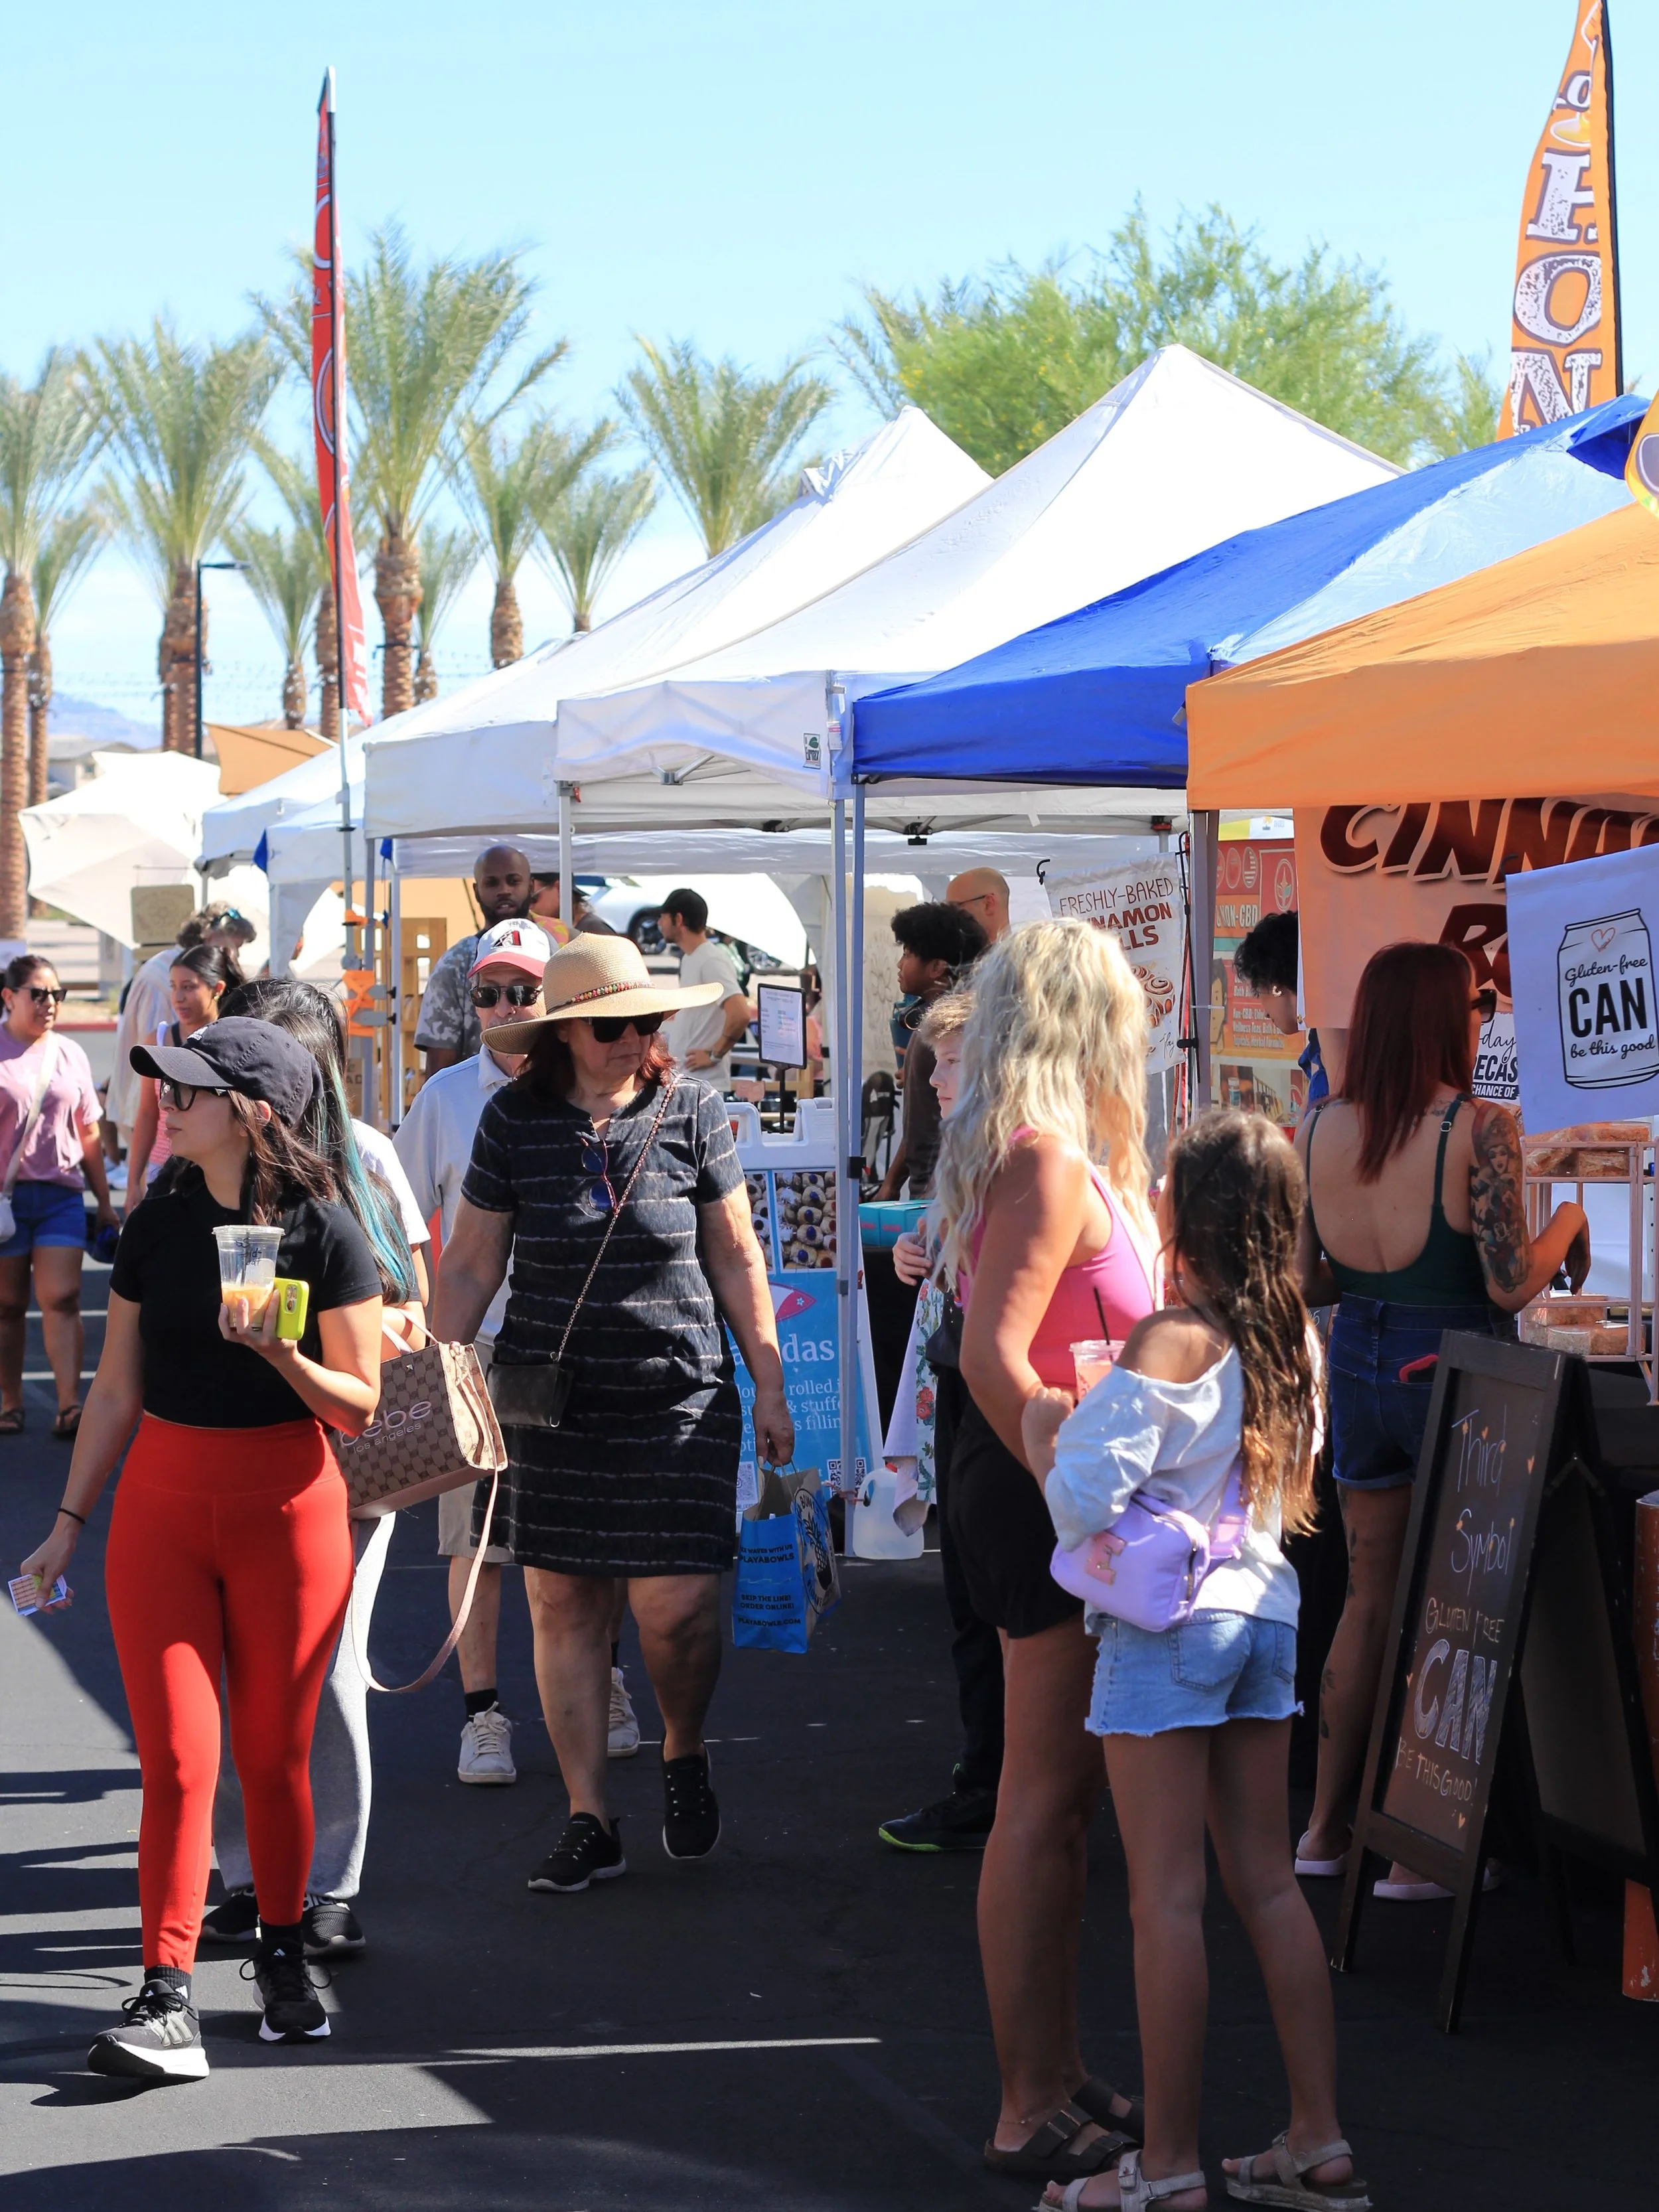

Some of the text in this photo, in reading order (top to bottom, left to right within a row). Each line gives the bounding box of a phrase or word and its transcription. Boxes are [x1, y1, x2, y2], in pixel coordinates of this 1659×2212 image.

[1060, 877, 1173, 917] FRESHLY-BAKED
[1088, 902, 1172, 929] NAMON
[1119, 925, 1159, 950] LLS
[1565, 954, 1648, 987] Gluten-free
[1569, 978, 1647, 1038] CAN
[1479, 1020, 1516, 1064] day
[1570, 1034, 1655, 1059] be this good
[1473, 1055, 1518, 1082] ECAS
[1504, 1086, 1516, 1098] OF
[788, 1378, 832, 1396] rolled
[787, 1400, 797, 1413] &
[806, 1414, 841, 1430] fillin
[353, 1422, 421, 1454] los angeles
[1451, 1404, 1507, 1497] Third
[1425, 1597, 1471, 1635] GLUTEN
[1413, 1639, 1498, 1765] CAN
[1395, 1736, 1415, 1769] BE
[1416, 1752, 1440, 1790] THIS
